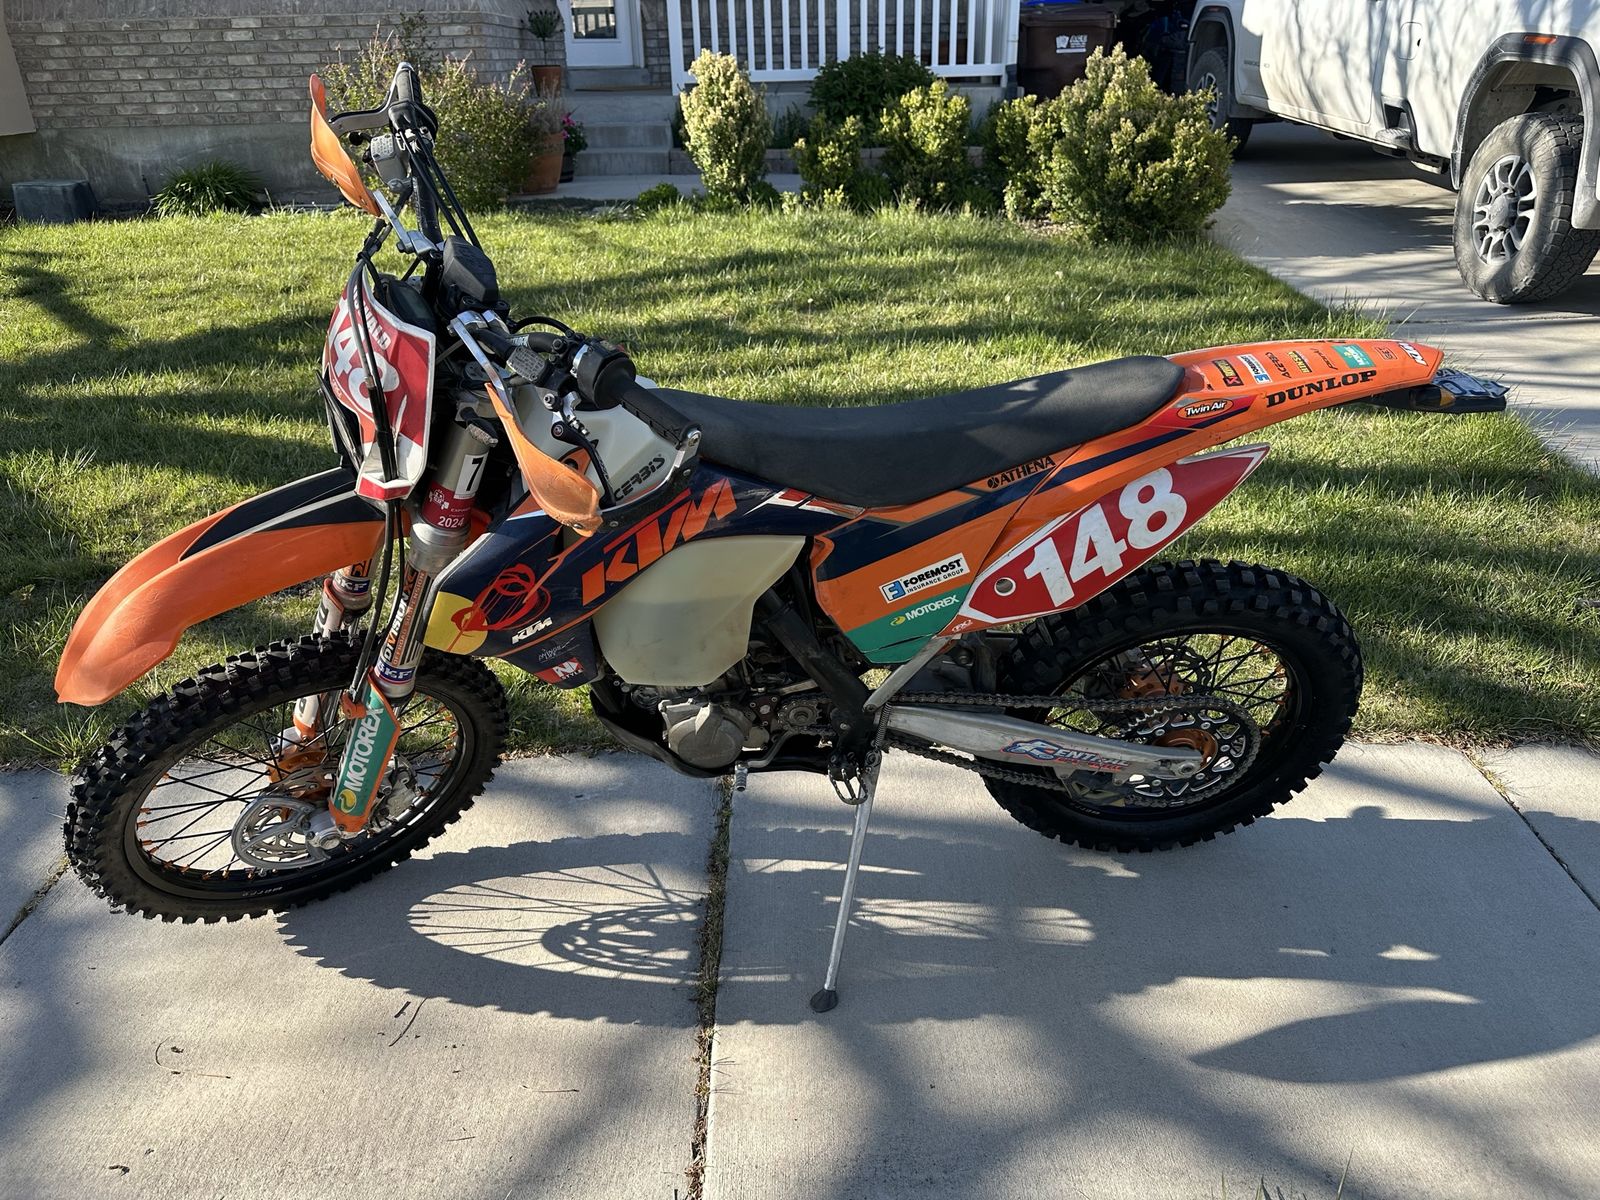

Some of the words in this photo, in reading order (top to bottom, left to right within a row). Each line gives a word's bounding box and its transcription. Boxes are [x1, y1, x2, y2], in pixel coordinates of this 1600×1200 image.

[1266, 370, 1377, 408] DUNLOP
[1185, 405, 1210, 417] Twin
[1211, 401, 1227, 412] Air
[466, 457, 484, 491] 7
[1000, 456, 1056, 485] ATHENA
[438, 515, 464, 528] 2024
[582, 478, 737, 606] KTM
[1024, 467, 1187, 607] 148
[903, 559, 962, 588] FOREMOST
[907, 578, 941, 593] INSURANCE
[943, 568, 964, 580] GROUP
[905, 595, 959, 620] MOTOREX
[384, 591, 409, 662] DIVISION
[512, 617, 553, 644] KTM
[377, 661, 412, 679] SKF
[343, 705, 384, 792] MOTOREX
